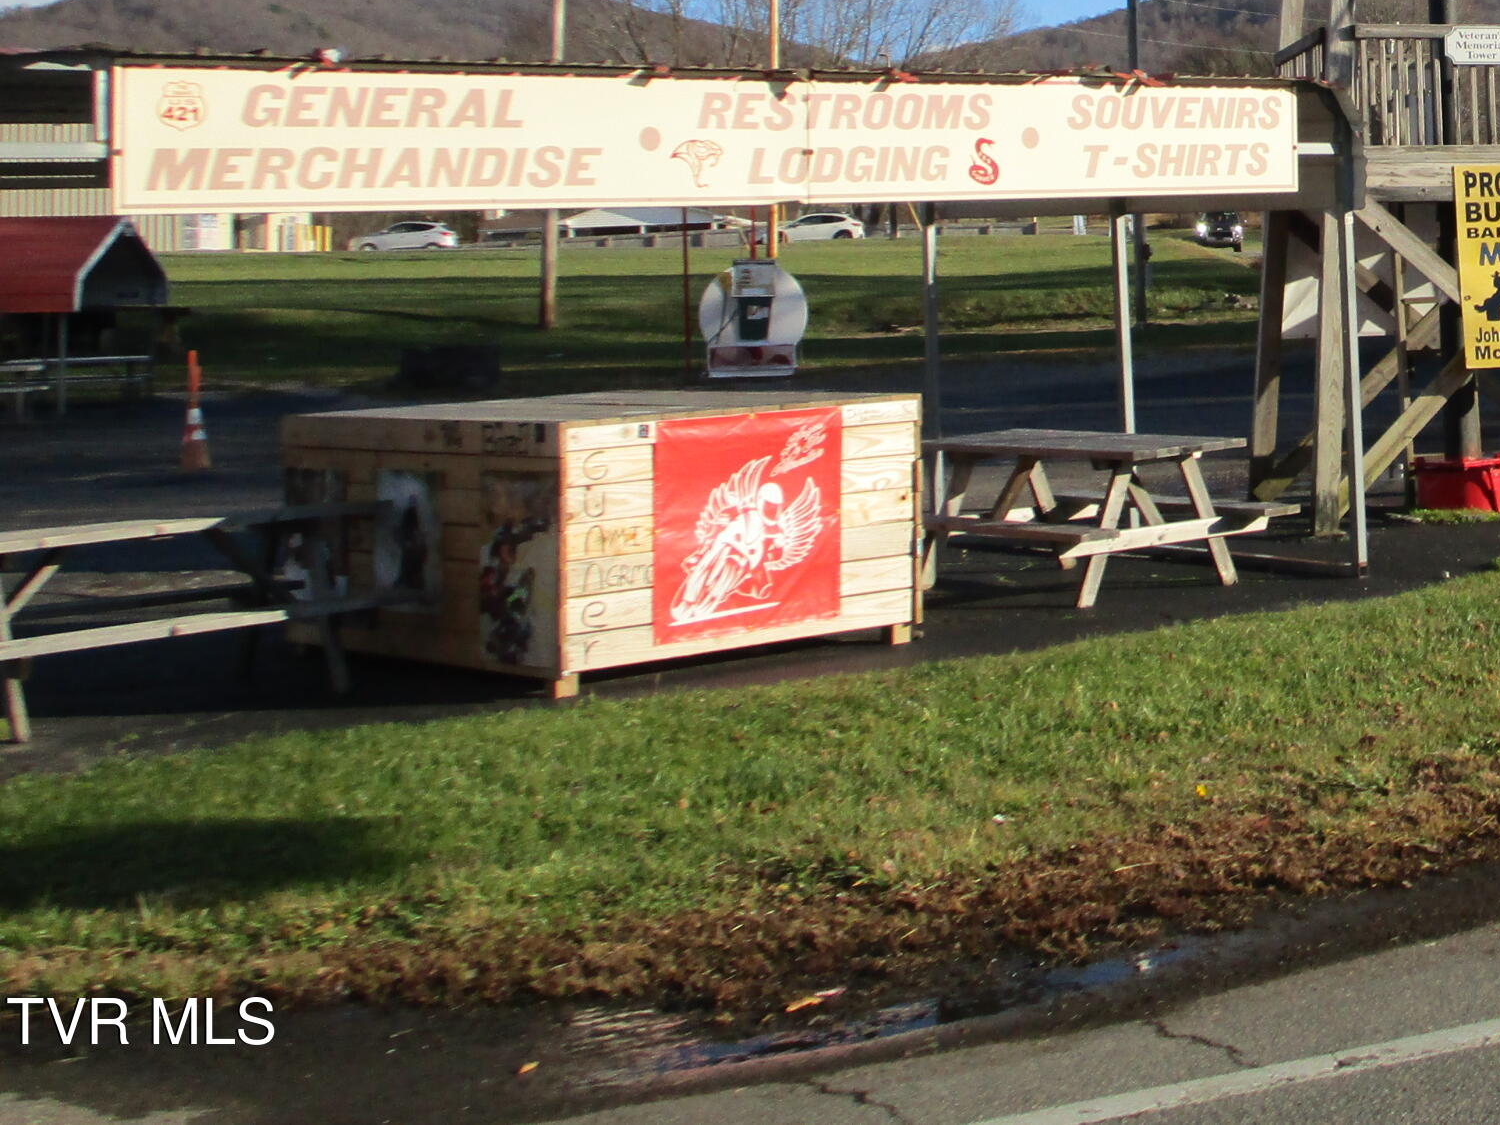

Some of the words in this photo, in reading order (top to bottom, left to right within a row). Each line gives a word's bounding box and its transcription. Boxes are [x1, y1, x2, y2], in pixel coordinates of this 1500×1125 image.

[1465, 50, 1498, 60] Tower
[161, 106, 199, 122] 421
[241, 83, 524, 129] GENERAL
[697, 91, 994, 131] RESTROOMS
[1066, 94, 1282, 131] SOUVENIRS
[144, 146, 603, 193] MERCHANDISE
[747, 144, 950, 187] LODGING
